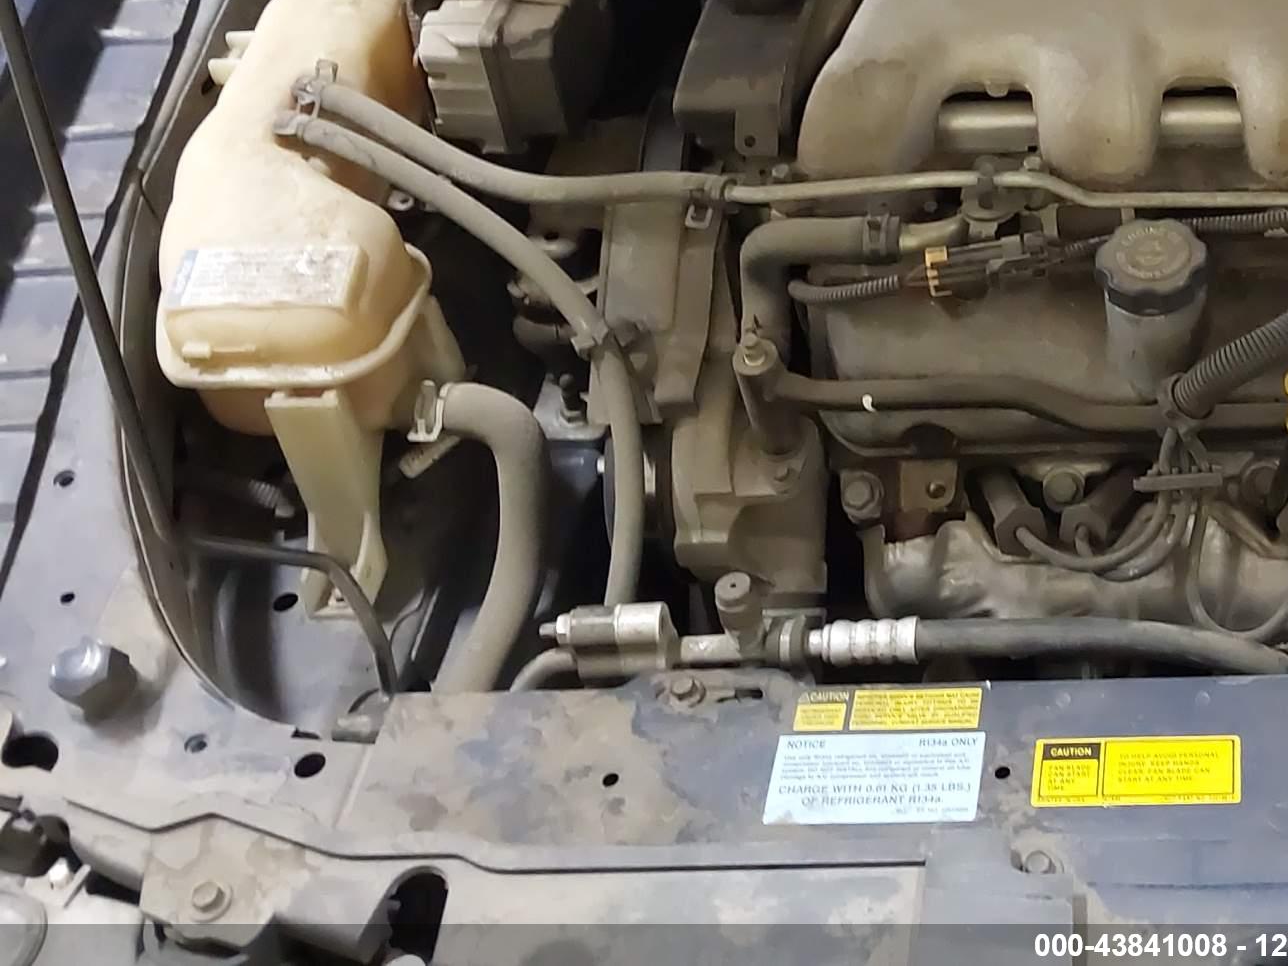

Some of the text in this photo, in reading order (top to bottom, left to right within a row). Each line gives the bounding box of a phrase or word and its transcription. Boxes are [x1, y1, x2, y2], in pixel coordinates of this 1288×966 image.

[810, 690, 850, 702] CAUTION
[787, 740, 826, 750] NOTICE
[951, 737, 979, 747] ONLY
[1050, 747, 1092, 757] CAUTION
[779, 785, 828, 795] CHARGE
[833, 784, 864, 795] WITH
[890, 783, 909, 794] KG
[801, 796, 818, 807] OF
[821, 795, 905, 806] REFRIGERANT
